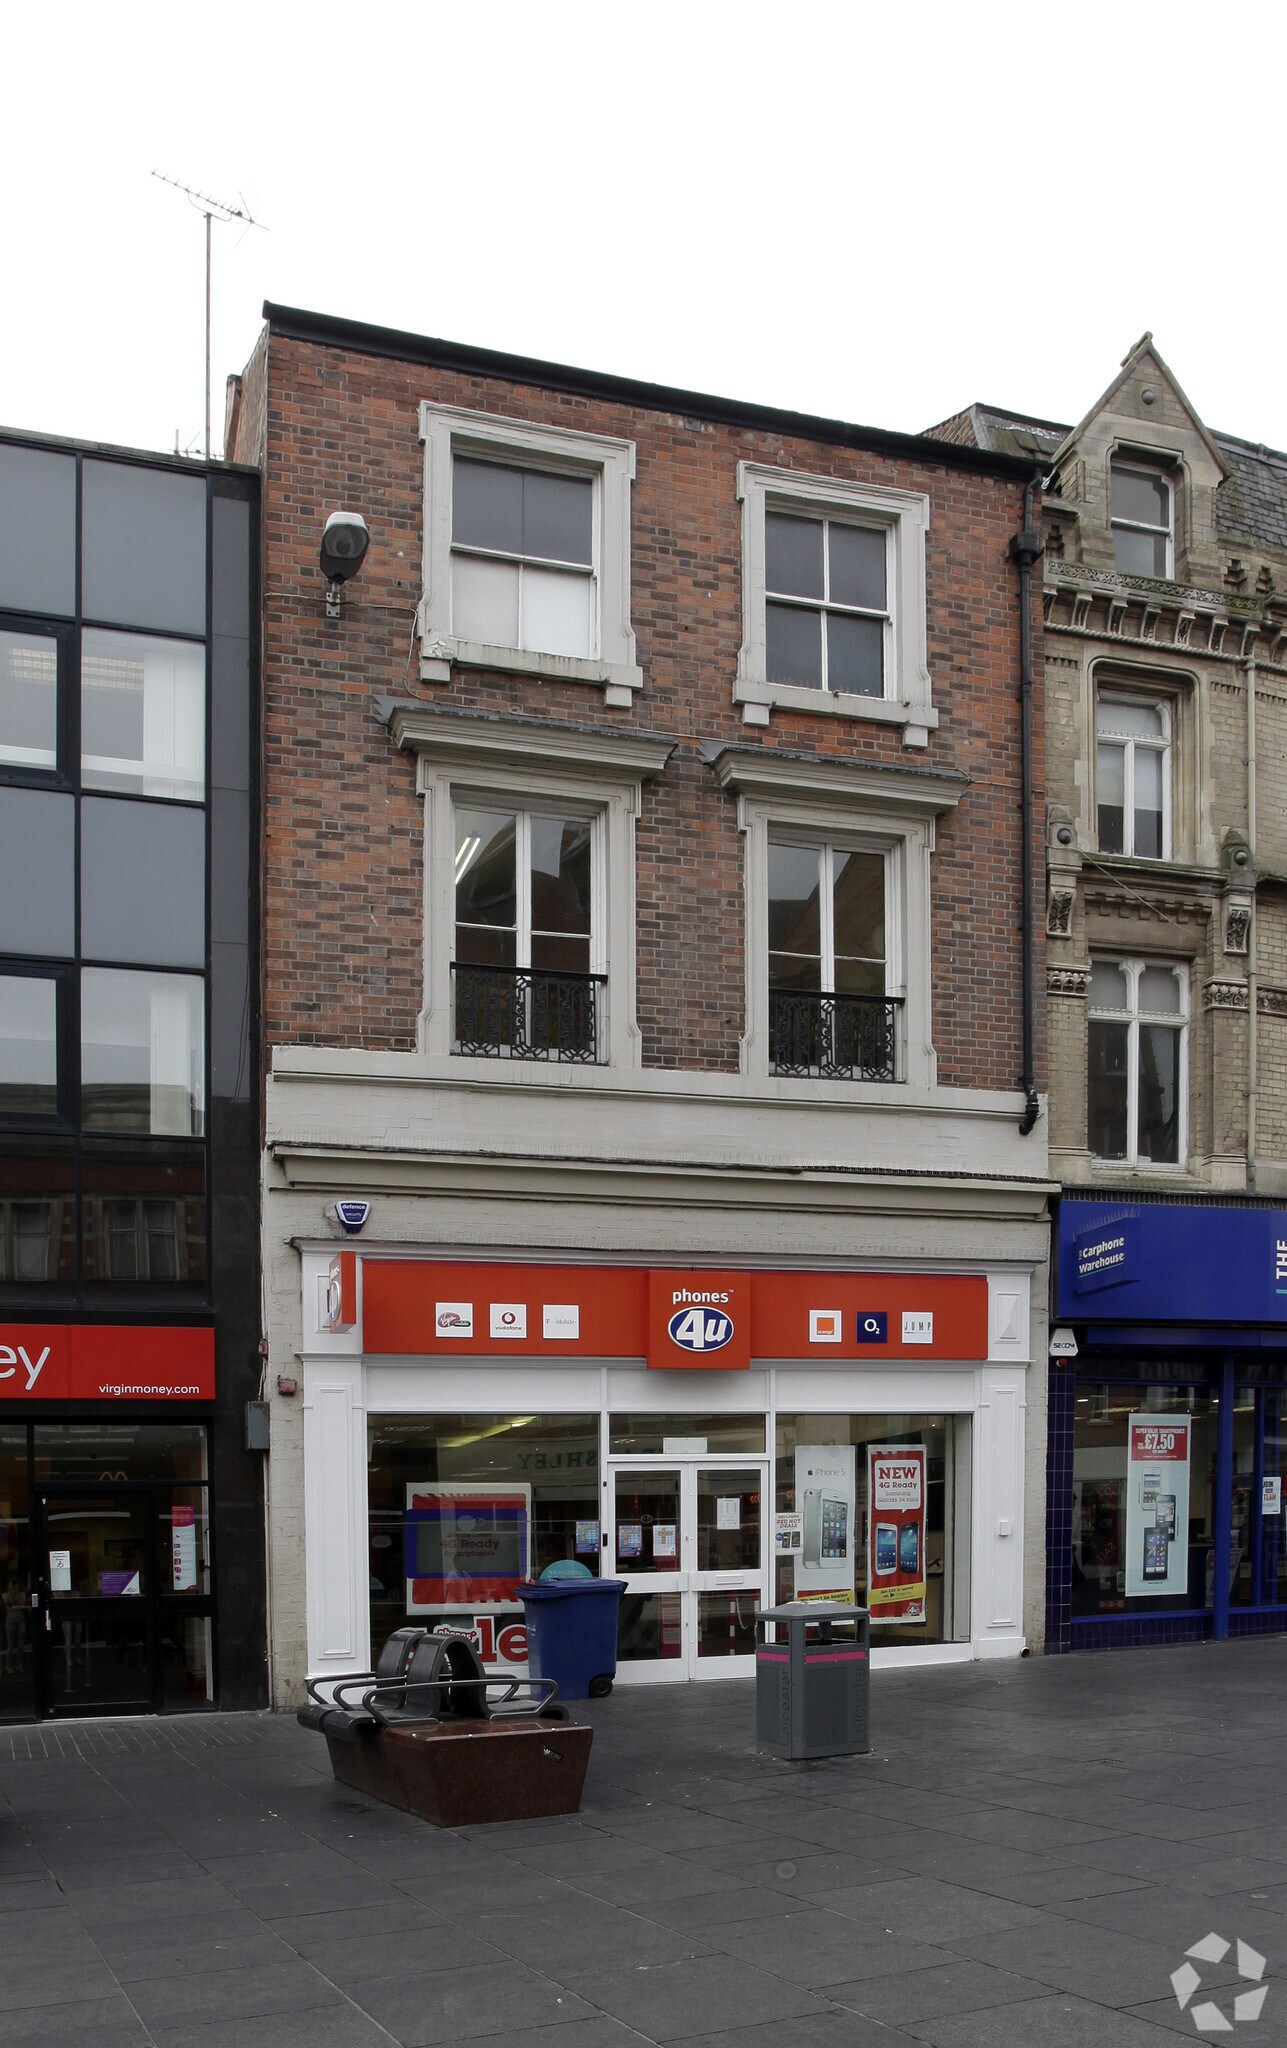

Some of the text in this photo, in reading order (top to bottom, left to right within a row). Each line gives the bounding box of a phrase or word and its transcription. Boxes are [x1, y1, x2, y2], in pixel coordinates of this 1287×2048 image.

[1082, 1237, 1125, 1258] Carphone
[1078, 1252, 1125, 1274] Warehouse
[675, 1309, 726, 1348] 4u
[99, 1383, 200, 1396] virginmoney.com
[1144, 1433, 1175, 1450] £7.50
[815, 1467, 846, 1476] iPhone 5
[878, 1466, 917, 1480] NEW
[892, 1481, 917, 1489] Ready
[461, 1538, 499, 1550] Ready
